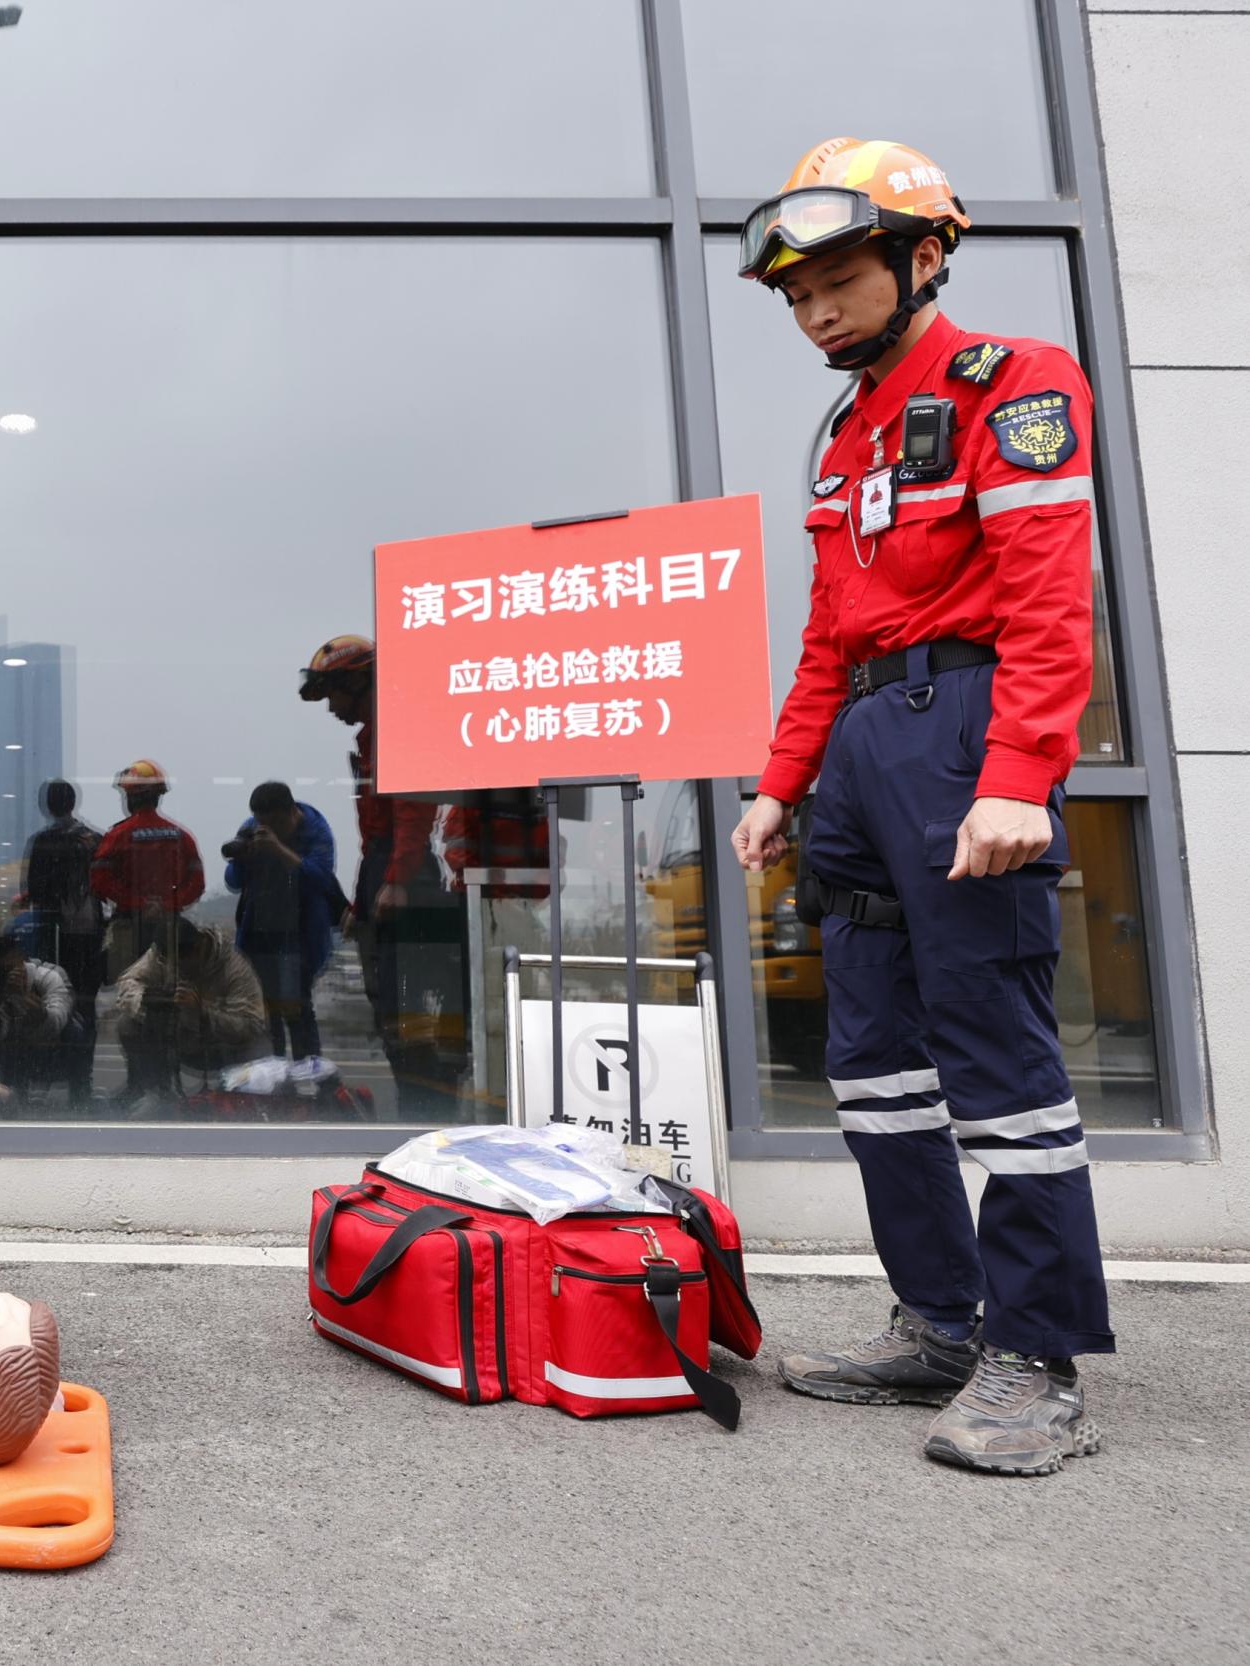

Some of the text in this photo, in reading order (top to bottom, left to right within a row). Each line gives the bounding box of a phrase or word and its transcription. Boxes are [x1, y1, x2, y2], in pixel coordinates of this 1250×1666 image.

[1011, 410, 1051, 424] RESCUE
[1034, 454, 1058, 465] 贵州
[401, 548, 742, 630] 演习演练科目7
[447, 640, 683, 696] 应急抢险救援
